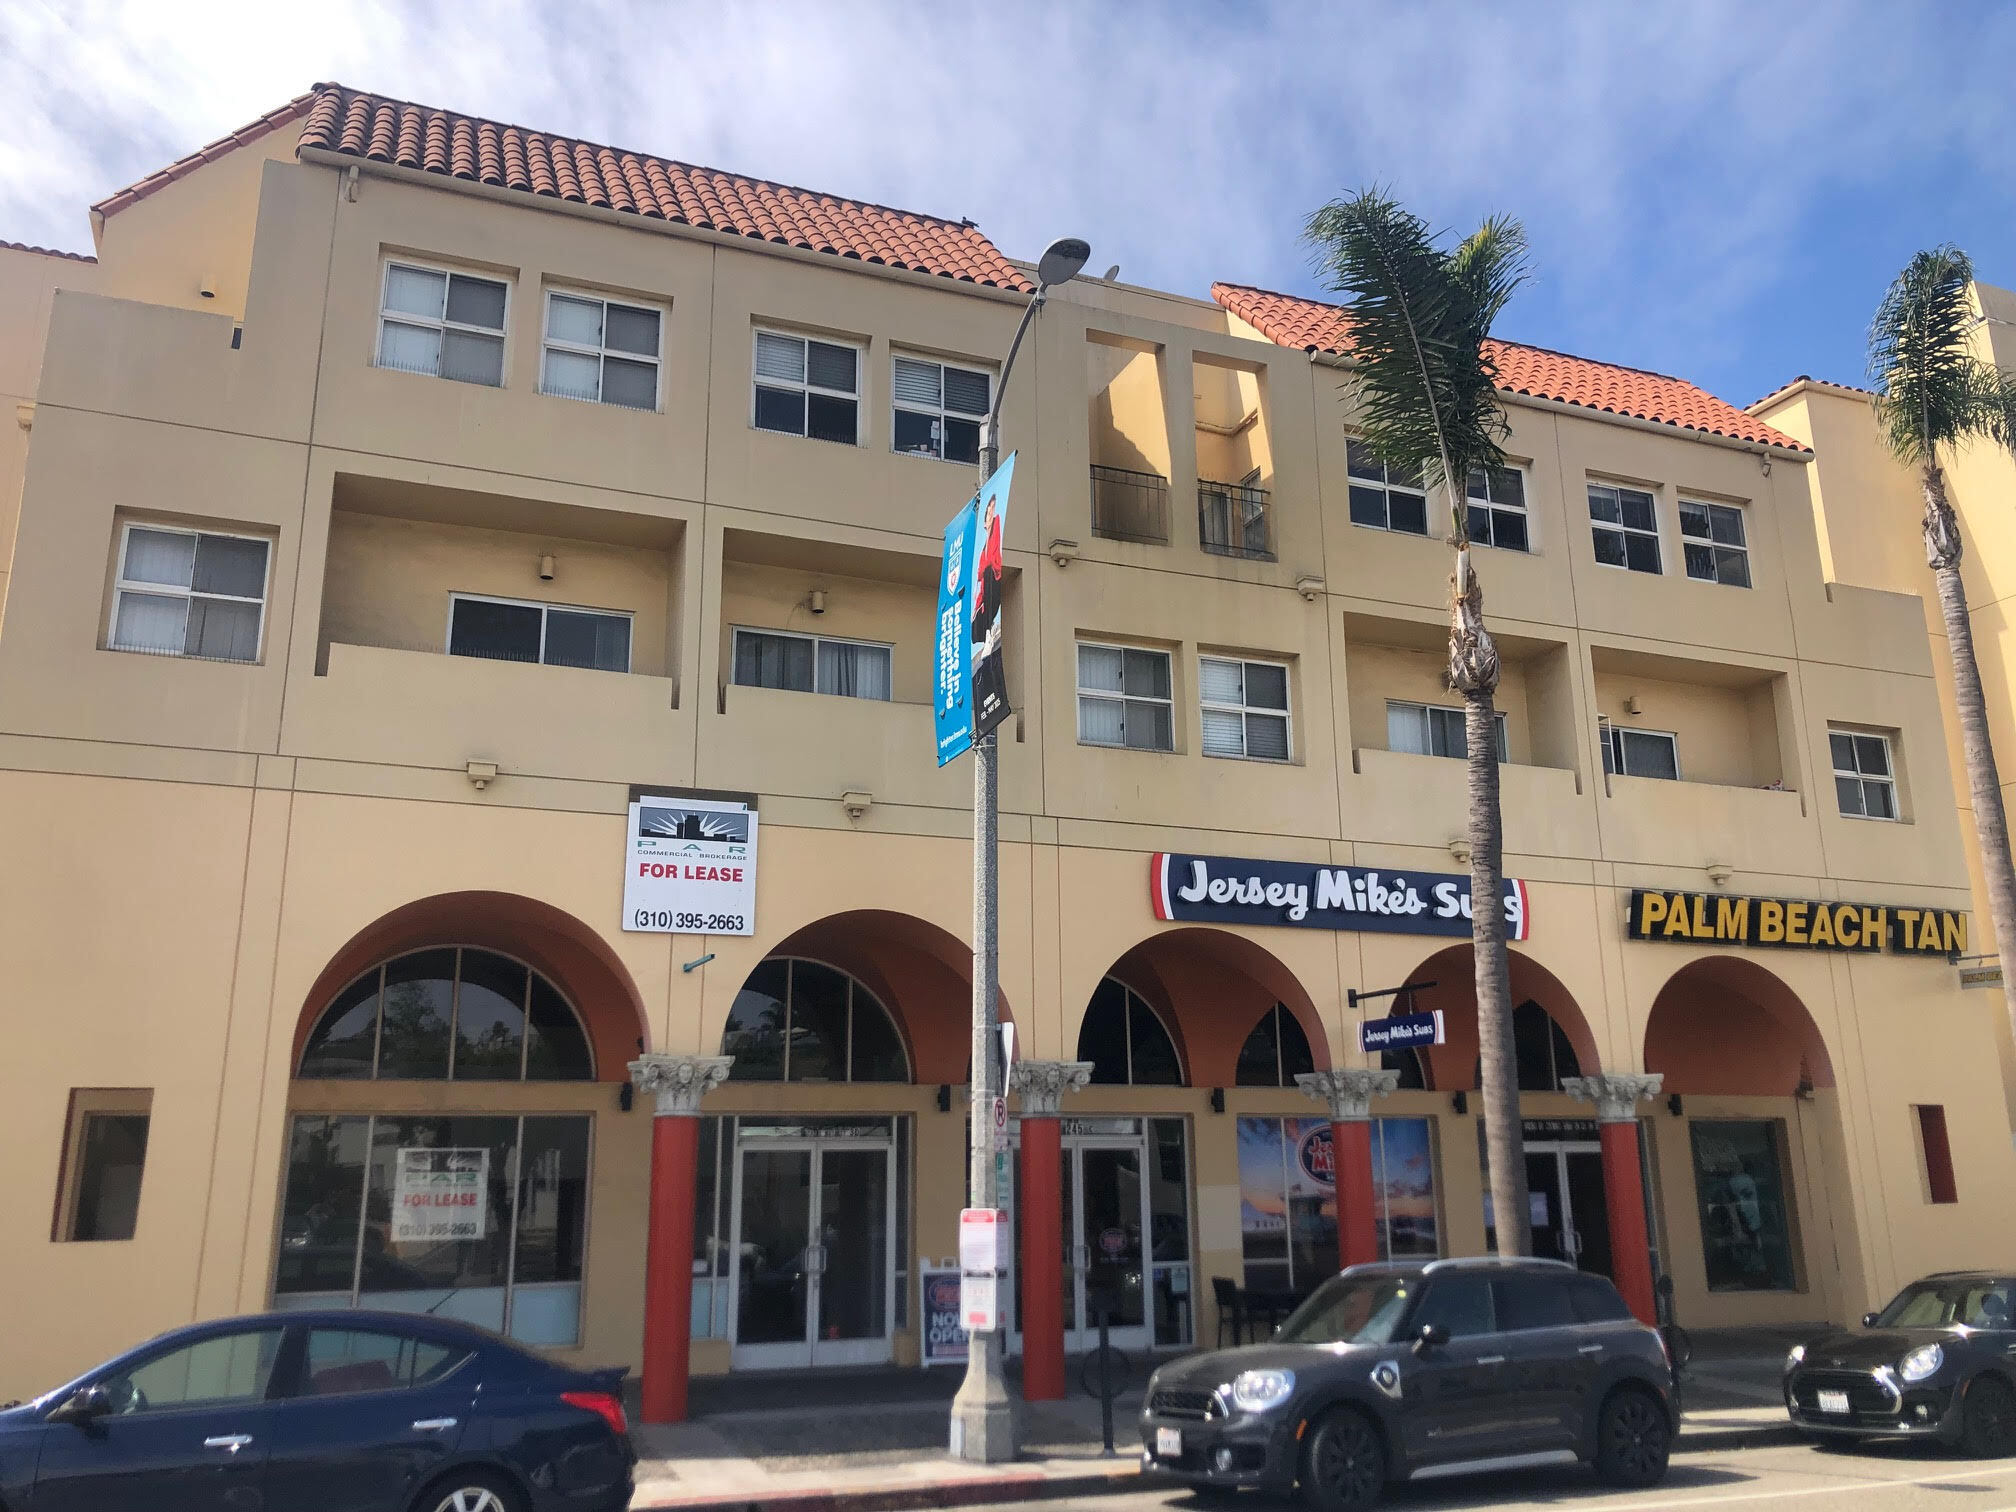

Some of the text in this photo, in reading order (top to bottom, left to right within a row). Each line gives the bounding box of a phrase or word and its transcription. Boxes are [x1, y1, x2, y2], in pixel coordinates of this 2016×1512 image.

[637, 850, 748, 861] COMMERCIAL BROKERAGE
[639, 863, 744, 882] FOR LEASE
[1177, 860, 1521, 922] Jersey Mike's Sus
[634, 909, 744, 931] (310) 395-2663
[1640, 892, 1968, 952] PALM BEACH TAN
[1365, 1029, 1389, 1044] Jersey
[1390, 1025, 1413, 1039] Mike's
[403, 1193, 478, 1208] FOR LEASE
